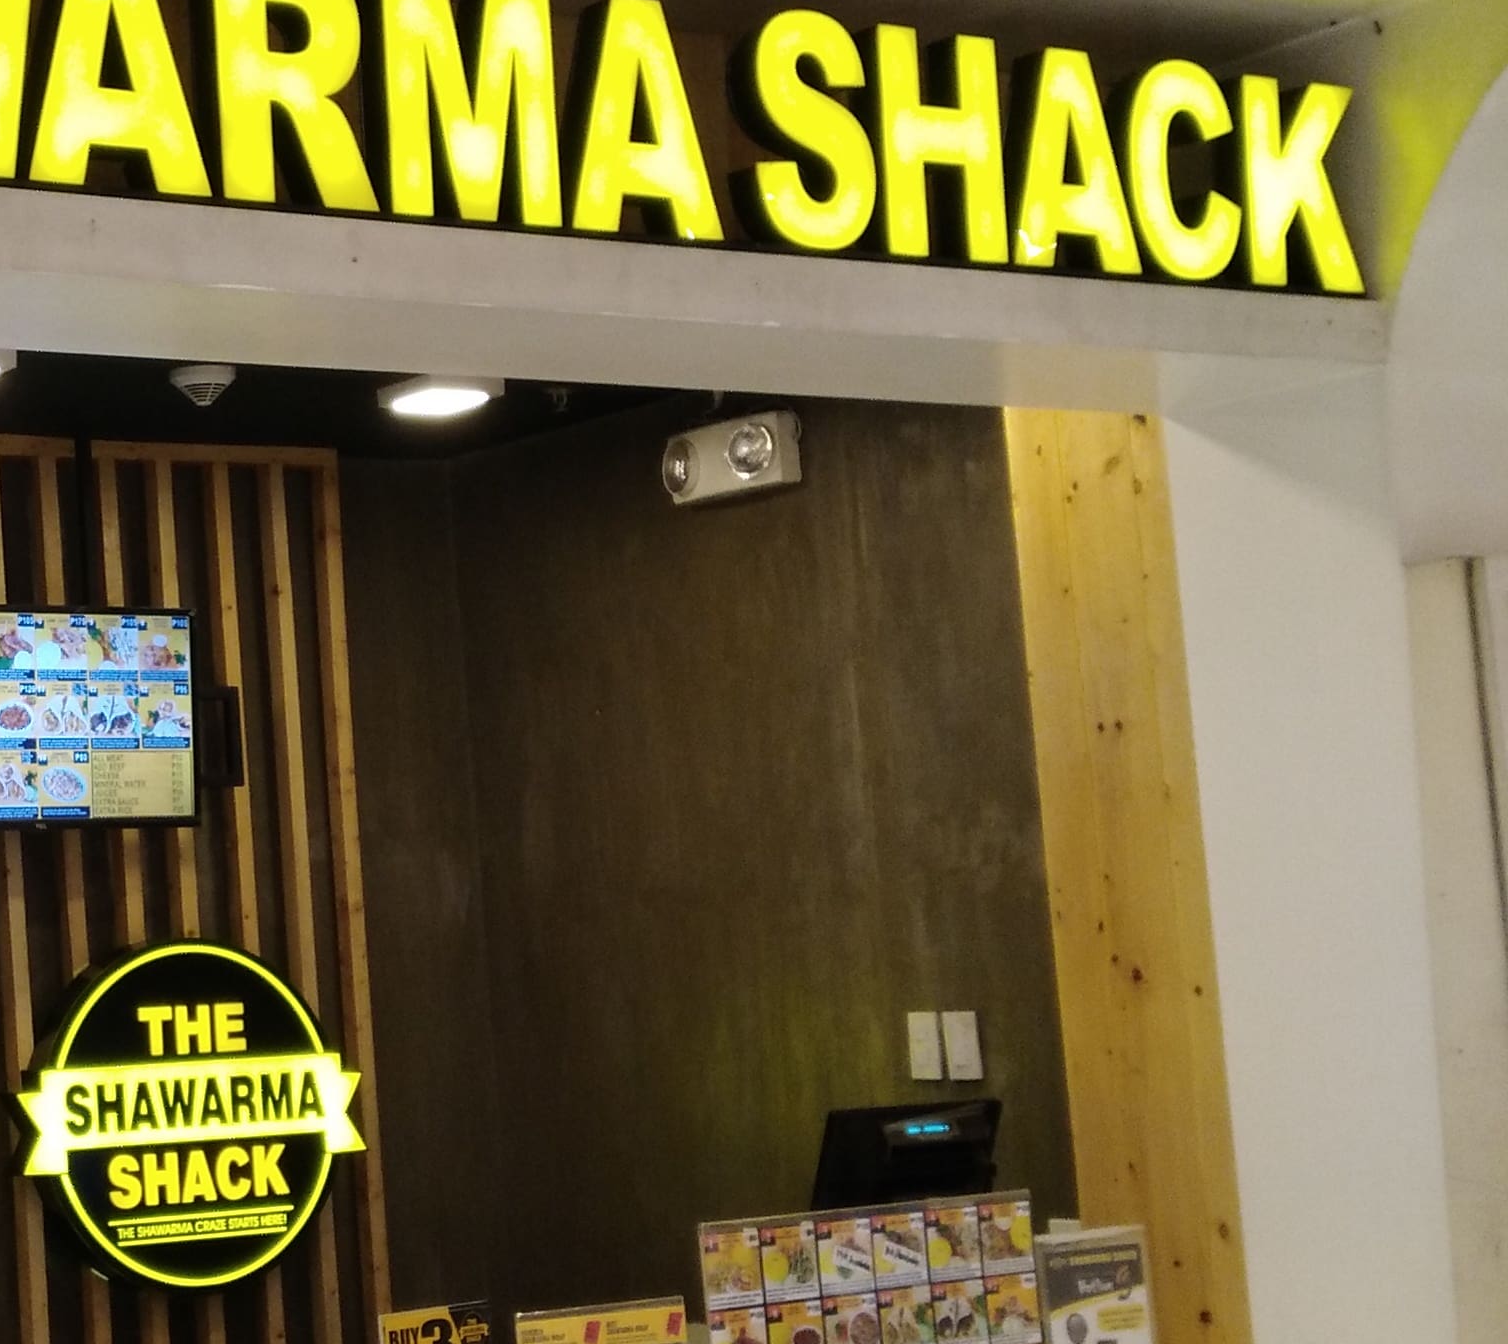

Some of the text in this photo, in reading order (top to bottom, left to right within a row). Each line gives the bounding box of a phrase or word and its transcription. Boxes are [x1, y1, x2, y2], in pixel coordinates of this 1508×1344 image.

[755, 9, 1365, 293] SHACK
[137, 1003, 247, 1056] THE
[65, 1071, 324, 1137] SHAWARMA
[108, 1144, 290, 1210] SHACK
[117, 1213, 287, 1240] THE SHAWARMA CRAZE STARTS HERE!
